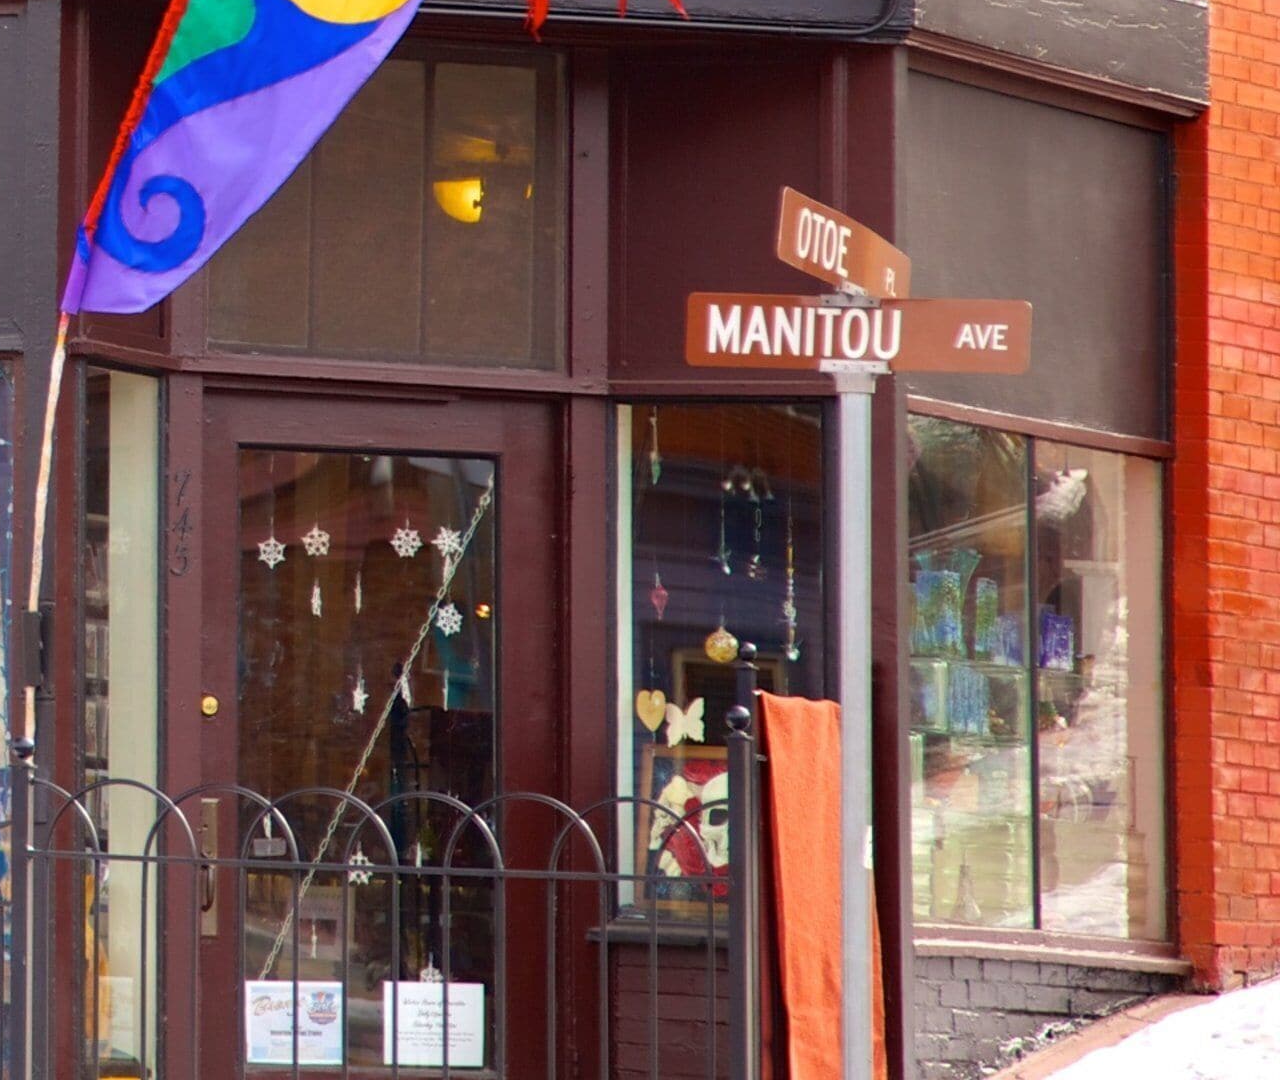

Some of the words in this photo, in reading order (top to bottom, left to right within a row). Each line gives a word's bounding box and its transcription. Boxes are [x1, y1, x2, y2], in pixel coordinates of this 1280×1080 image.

[796, 207, 851, 278] OTOE
[884, 266, 897, 297] PL
[706, 303, 902, 360] MANITOU
[955, 323, 1008, 350] AVE
